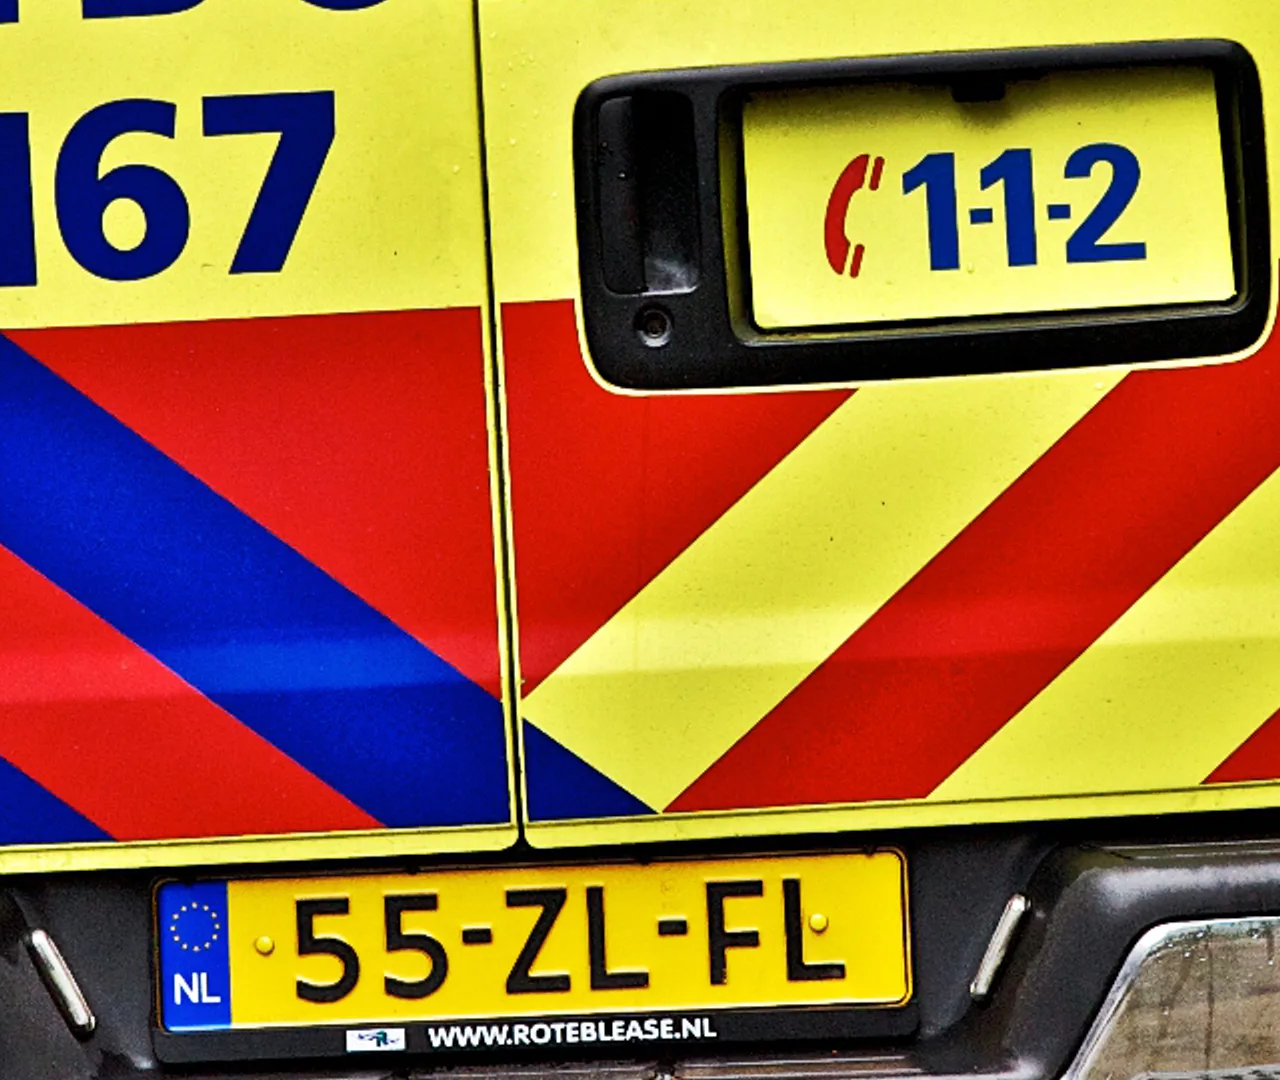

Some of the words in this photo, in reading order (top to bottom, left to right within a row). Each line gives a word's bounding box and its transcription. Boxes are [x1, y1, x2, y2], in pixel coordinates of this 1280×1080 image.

[901, 142, 1148, 272] 1-1-2
[294, 877, 847, 1005] 55-ZL-FL
[173, 971, 222, 1006] NL
[428, 1016, 718, 1049] WWW.ROTEBLEASE.NL
